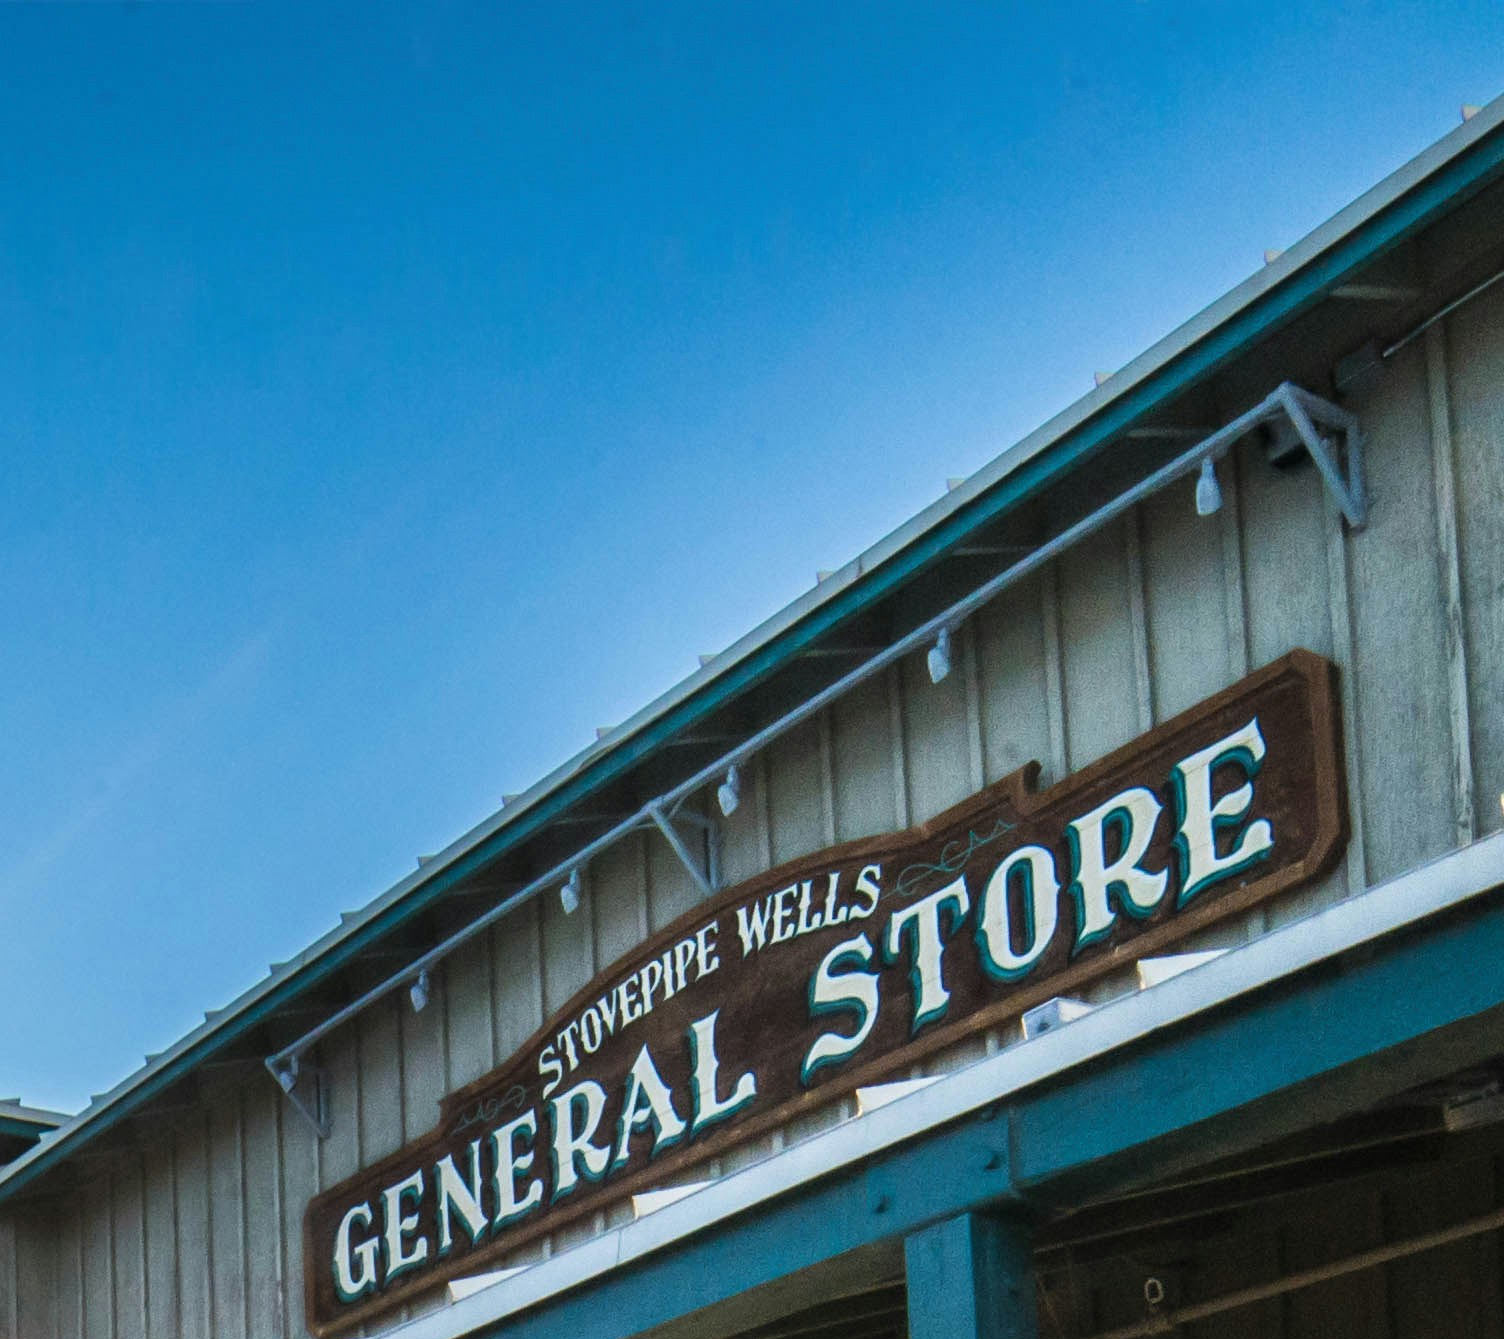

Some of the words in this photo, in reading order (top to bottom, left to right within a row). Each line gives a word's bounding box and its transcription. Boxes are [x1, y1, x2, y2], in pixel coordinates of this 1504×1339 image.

[333, 1010, 757, 1301] GENERAL
[803, 716, 1275, 1084] STORE
[538, 919, 720, 1099] STOVEPIPE
[737, 863, 883, 956] WELLS
